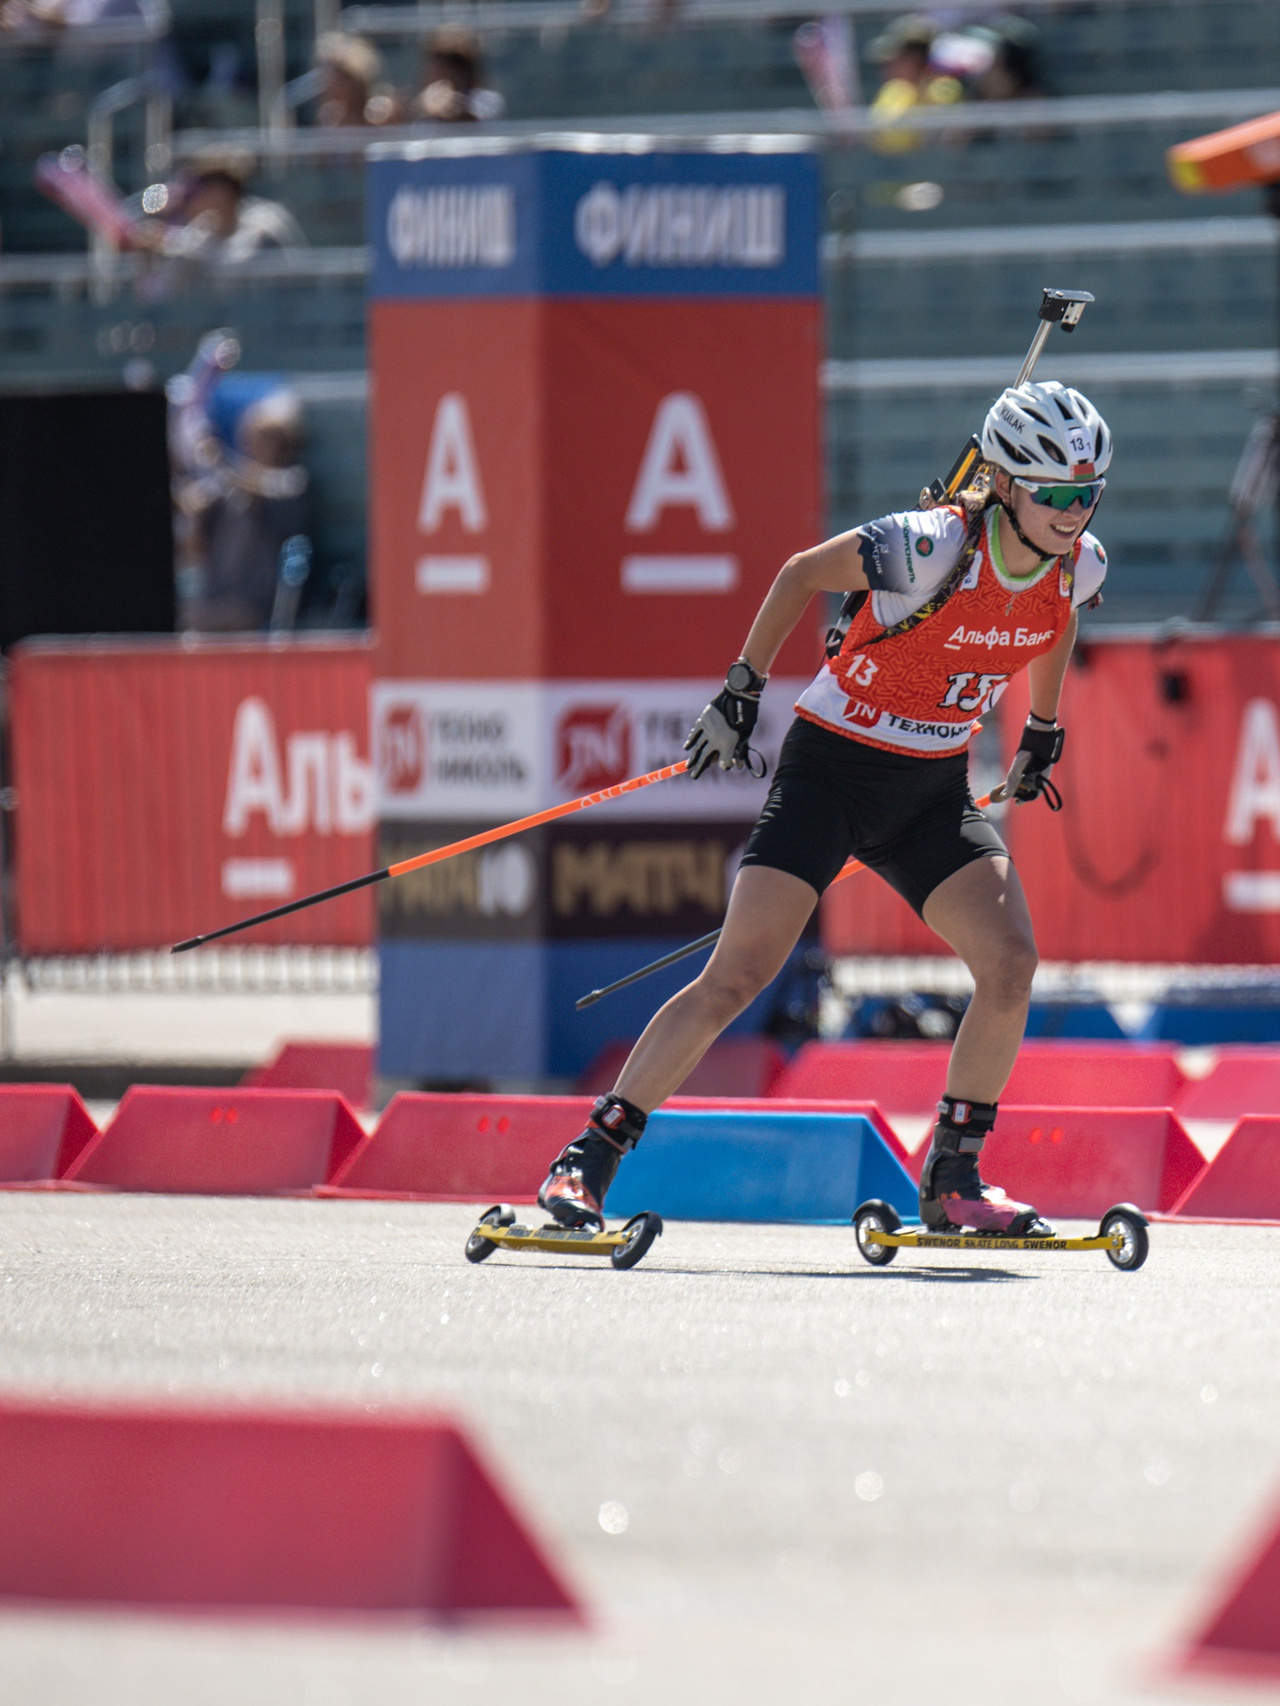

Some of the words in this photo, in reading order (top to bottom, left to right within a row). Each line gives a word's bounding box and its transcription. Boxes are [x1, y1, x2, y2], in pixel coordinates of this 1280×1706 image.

[387, 184, 516, 266] ФИНИШ
[576, 182, 785, 266] ФИНИШ
[1000, 406, 1026, 434] KULAK
[417, 393, 488, 532] А
[625, 391, 734, 532] А
[948, 625, 1010, 650] Альфа
[845, 654, 878, 686] 13
[917, 1237, 961, 1248] SWENOR
[964, 1240, 992, 1249] SKATE
[995, 1241, 1018, 1249] LONG
[1022, 1240, 1067, 1250] SWENOR
